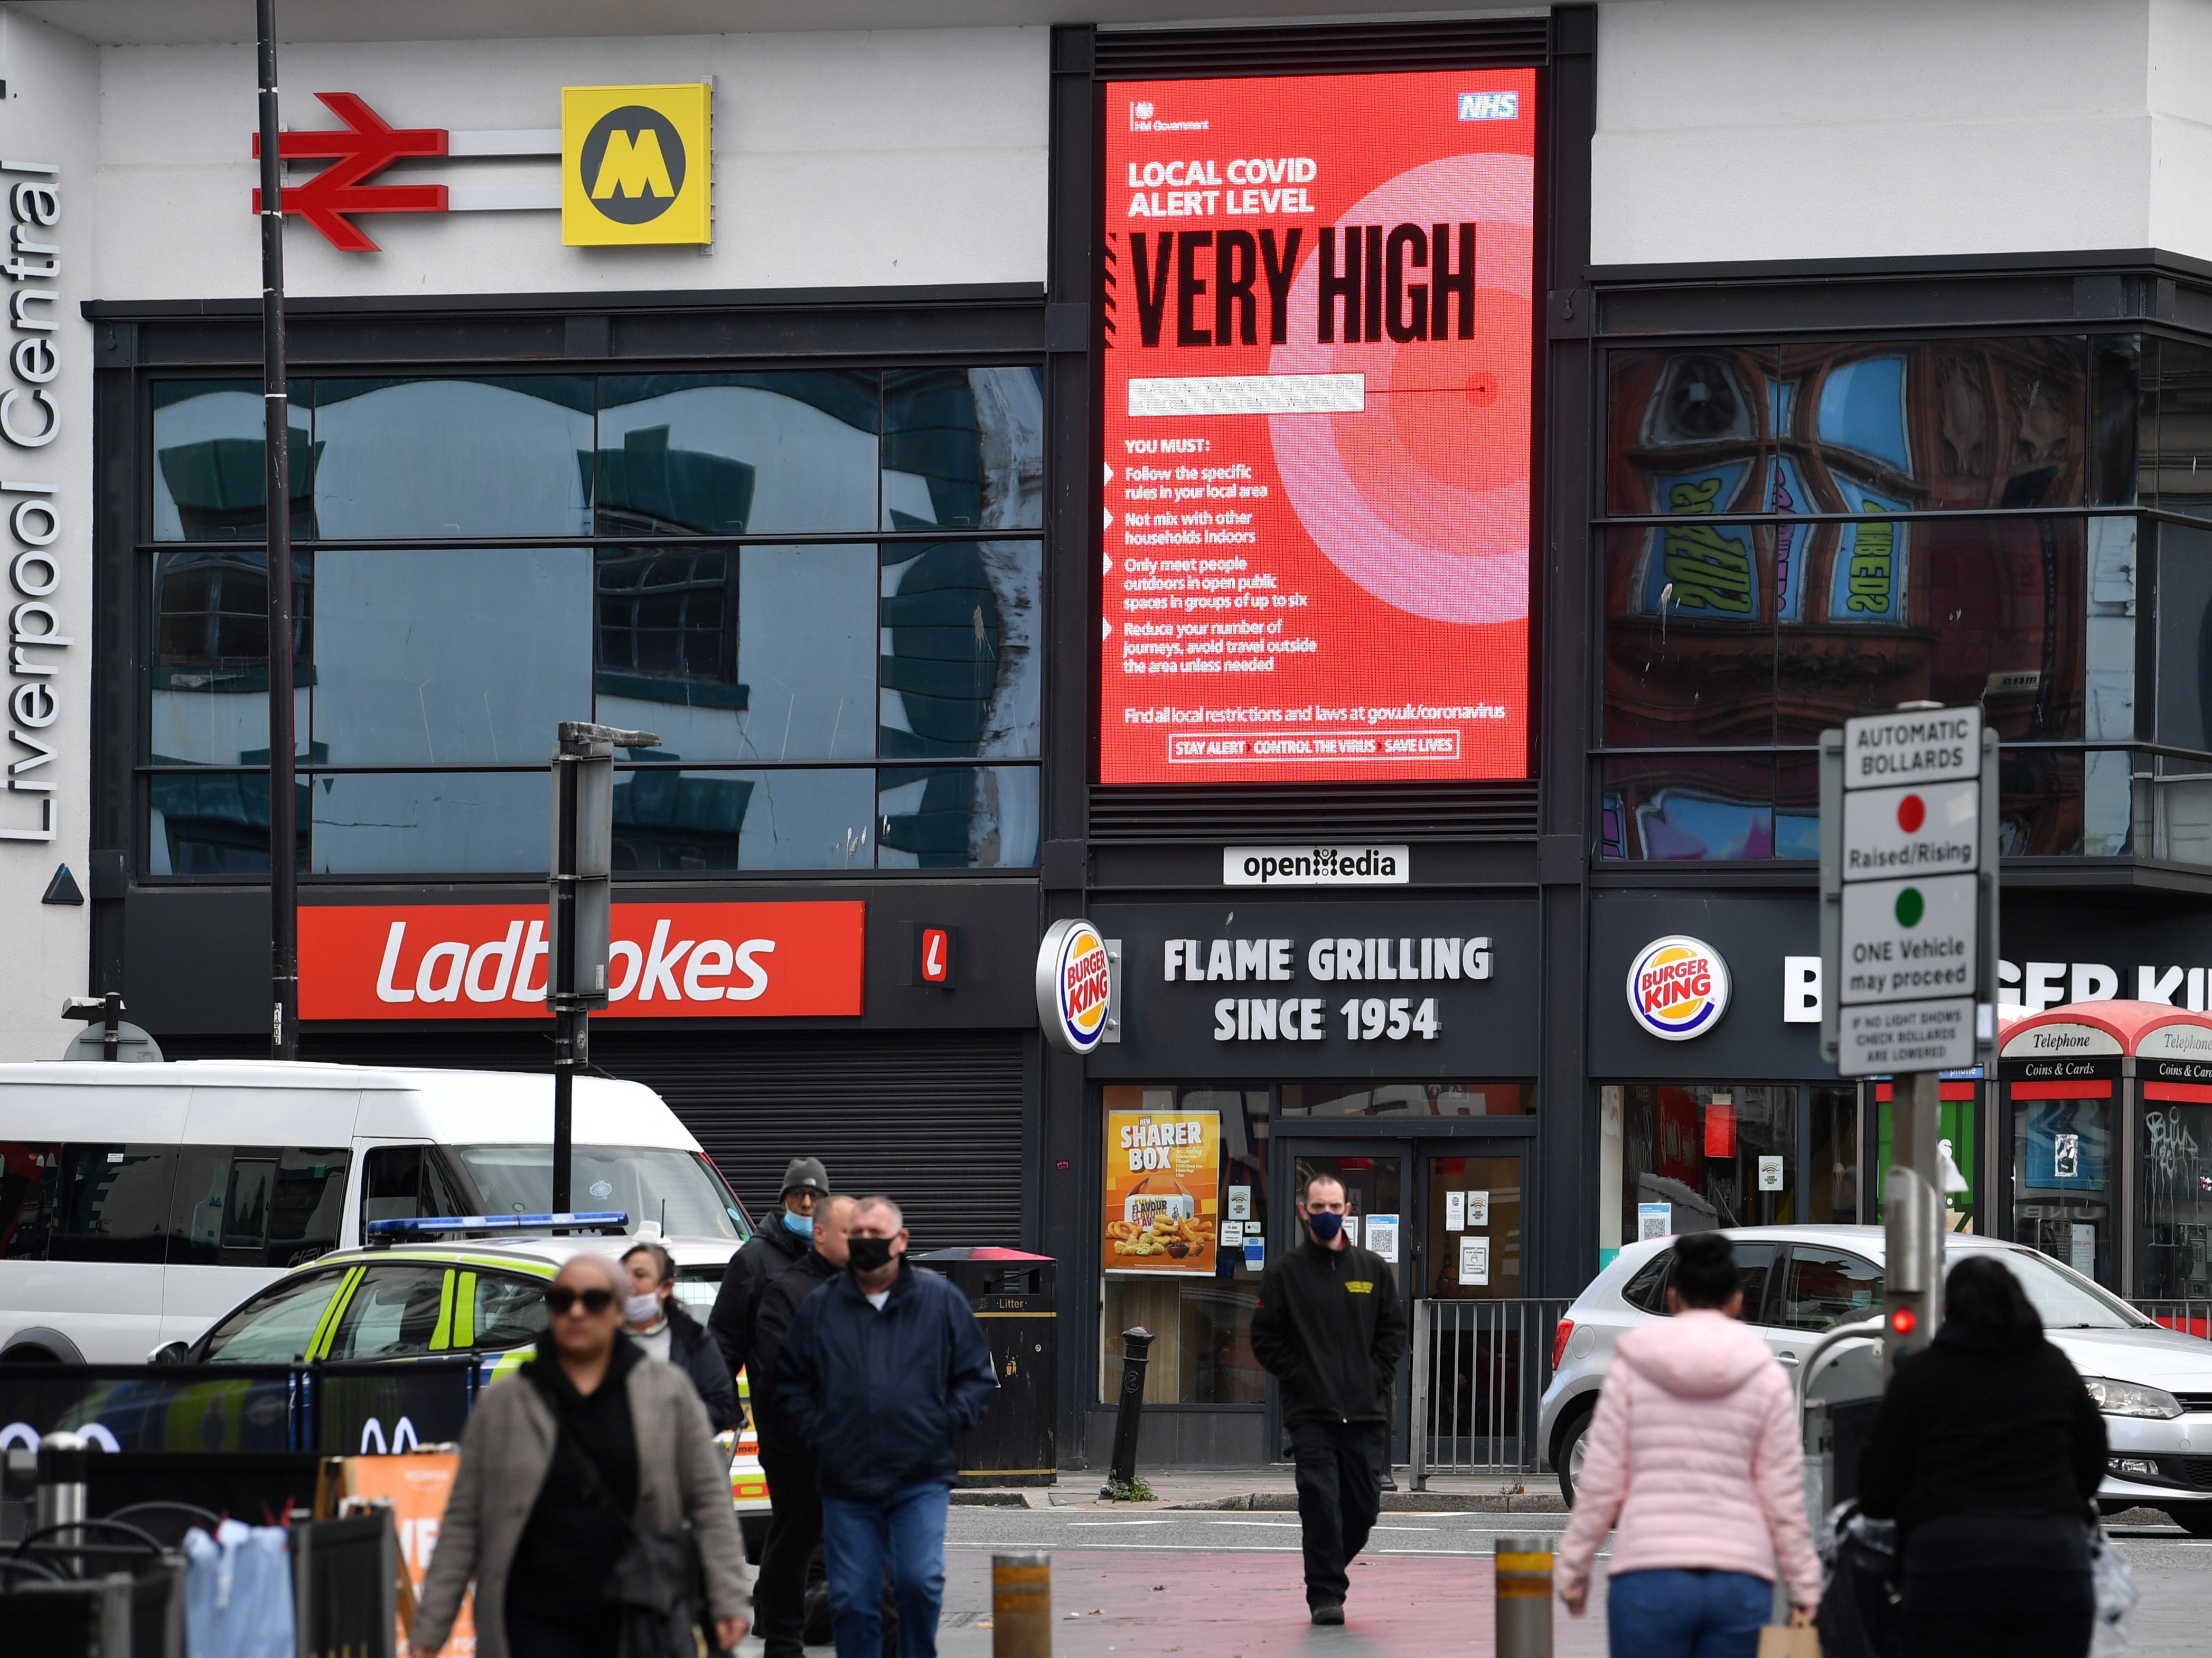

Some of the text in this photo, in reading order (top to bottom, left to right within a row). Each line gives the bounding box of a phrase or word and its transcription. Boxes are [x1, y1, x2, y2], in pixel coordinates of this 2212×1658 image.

[1459, 93, 1516, 119] NHS
[1134, 119, 1209, 132] HM Government
[1128, 157, 1317, 188] LOCAL COVID
[1128, 188, 1315, 218] ALERT LEVEL
[1129, 222, 1476, 348] VERY HIGH
[1125, 438, 1210, 454] YOU MUST:
[1126, 464, 1252, 483] Follow the specific
[0, 160, 75, 841] Liverpool Central
[1126, 483, 1268, 503] rules in your local area
[1125, 510, 1253, 527] Not mix with other
[1125, 530, 1202, 545] households
[1124, 555, 1247, 576] Only meet people
[1123, 574, 1278, 593] outdoors in open public
[1123, 592, 1308, 612] spaces in groups of up to six
[1123, 618, 1283, 639] Reduce your number of
[1122, 637, 1318, 658] journeys, avoid travel outside
[1122, 656, 1274, 673] the area unless needed
[1124, 706, 1154, 724] Find
[1155, 706, 1171, 723] all
[1171, 706, 1204, 723] local
[1206, 706, 1283, 723] restrictions
[1285, 704, 1313, 721] and
[1316, 704, 1348, 721] laws
[1350, 706, 1366, 720] at
[1857, 719, 1969, 748] AUTOMATIC
[1175, 738, 1452, 755] STAY ALERT CONTROL THE VIRUS SAVE LIVES
[1862, 747, 1964, 775] BOLLARDS
[1850, 841, 1972, 868] Raised/Rising
[1243, 849, 1396, 883] openMedia
[1164, 936, 1493, 981] FLAME GRILLING
[1853, 936, 1965, 963] ONE Vehicle
[376, 918, 776, 1003] Ladbokes
[1067, 949, 1106, 990] BURGER
[1642, 959, 1709, 991] BURGER
[1850, 962, 1967, 994] may proceed
[1068, 969, 1108, 1019] KING
[1645, 973, 1711, 1014] KING
[1213, 998, 1441, 1041] SINCE 1954
[1852, 1010, 1962, 1029] IF NO LIGHT SHOWS
[1856, 1027, 1956, 1047] CHECK BOLLARDS
[2033, 1034, 2090, 1051] Telephone
[1867, 1045, 1946, 1063] ARE LOWERED
[1949, 1066, 1976, 1078] phone
[2025, 1062, 2095, 1076] Coins & Cards
[2159, 1062, 2183, 1076] Coins
[2183, 1064, 2192, 1076] &
[1120, 1121, 1202, 1148] SHARER
[1129, 1146, 1171, 1171] BOX
[1132, 1200, 1167, 1213] FLAVOUR
[999, 1298, 1024, 1308] Litter
